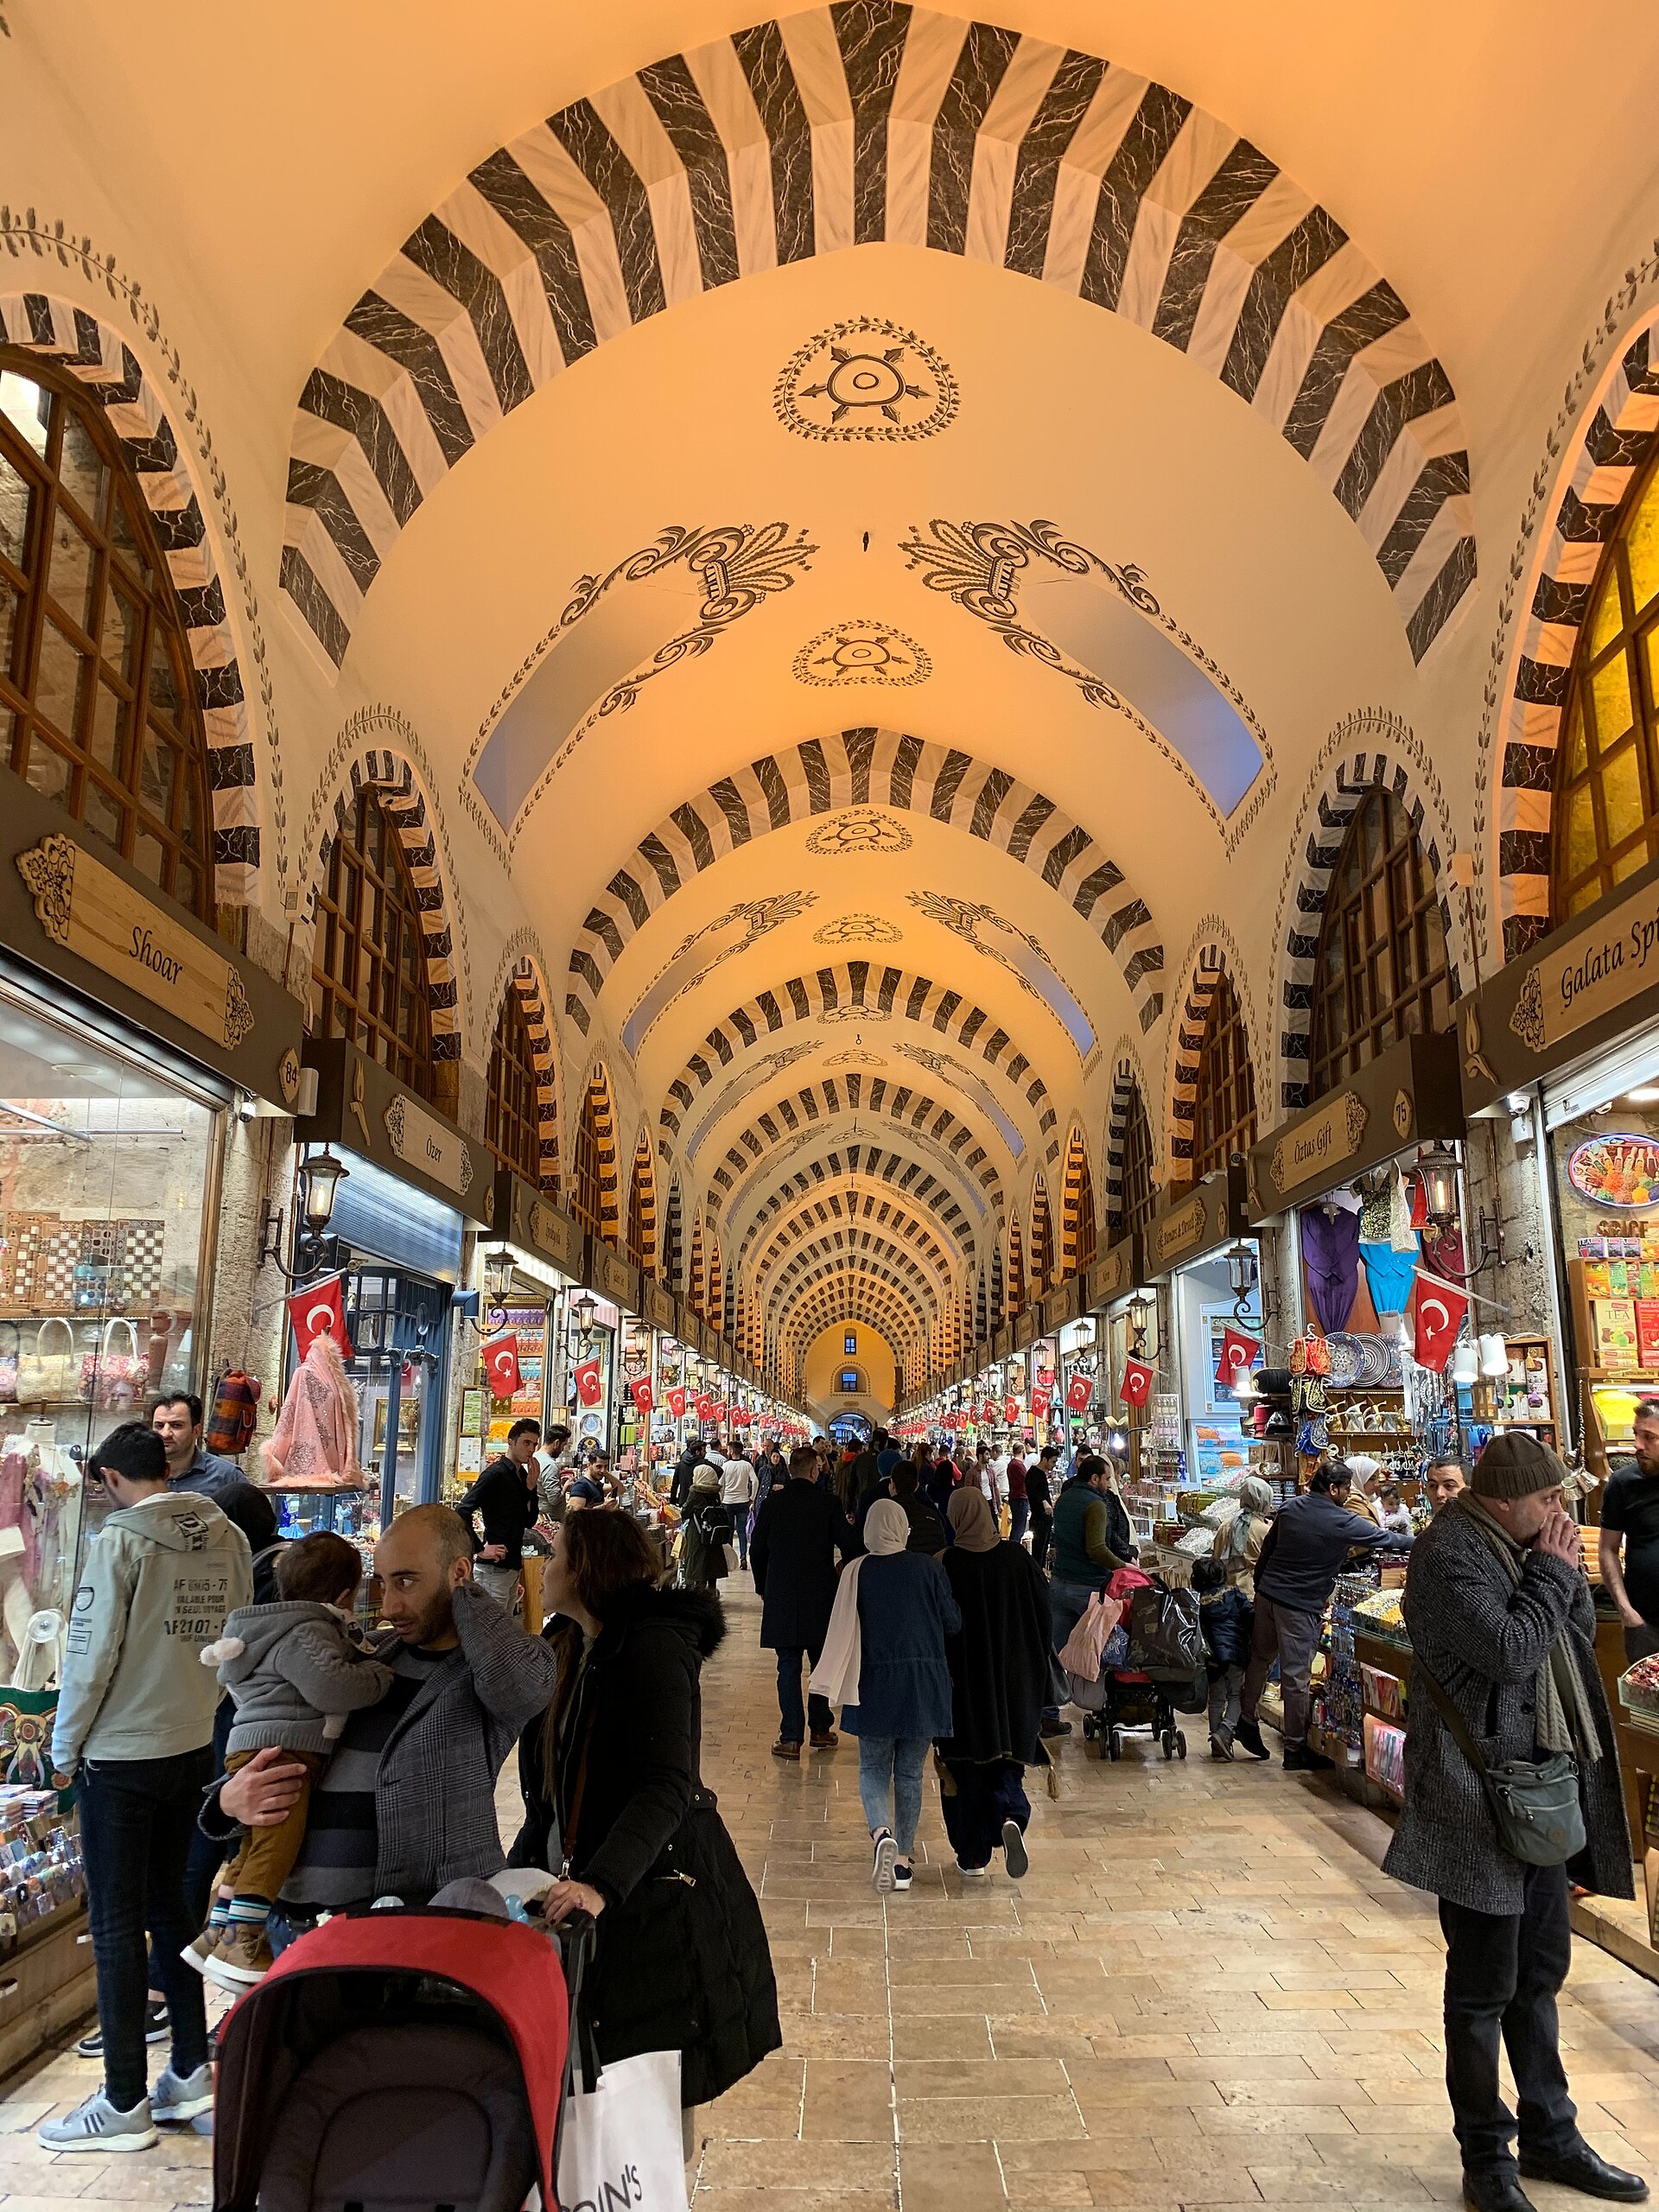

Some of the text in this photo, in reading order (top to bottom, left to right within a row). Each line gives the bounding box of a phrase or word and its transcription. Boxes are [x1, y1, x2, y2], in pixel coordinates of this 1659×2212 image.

[129, 926, 183, 985] Shoar
[1560, 944, 1625, 1008] Galata
[286, 1061, 297, 1088] 84
[1396, 1101, 1408, 1127] 75
[426, 1135, 442, 1163] Özer
[1317, 1121, 1332, 1156] Gift
[1605, 1310, 1630, 1320] TEA
